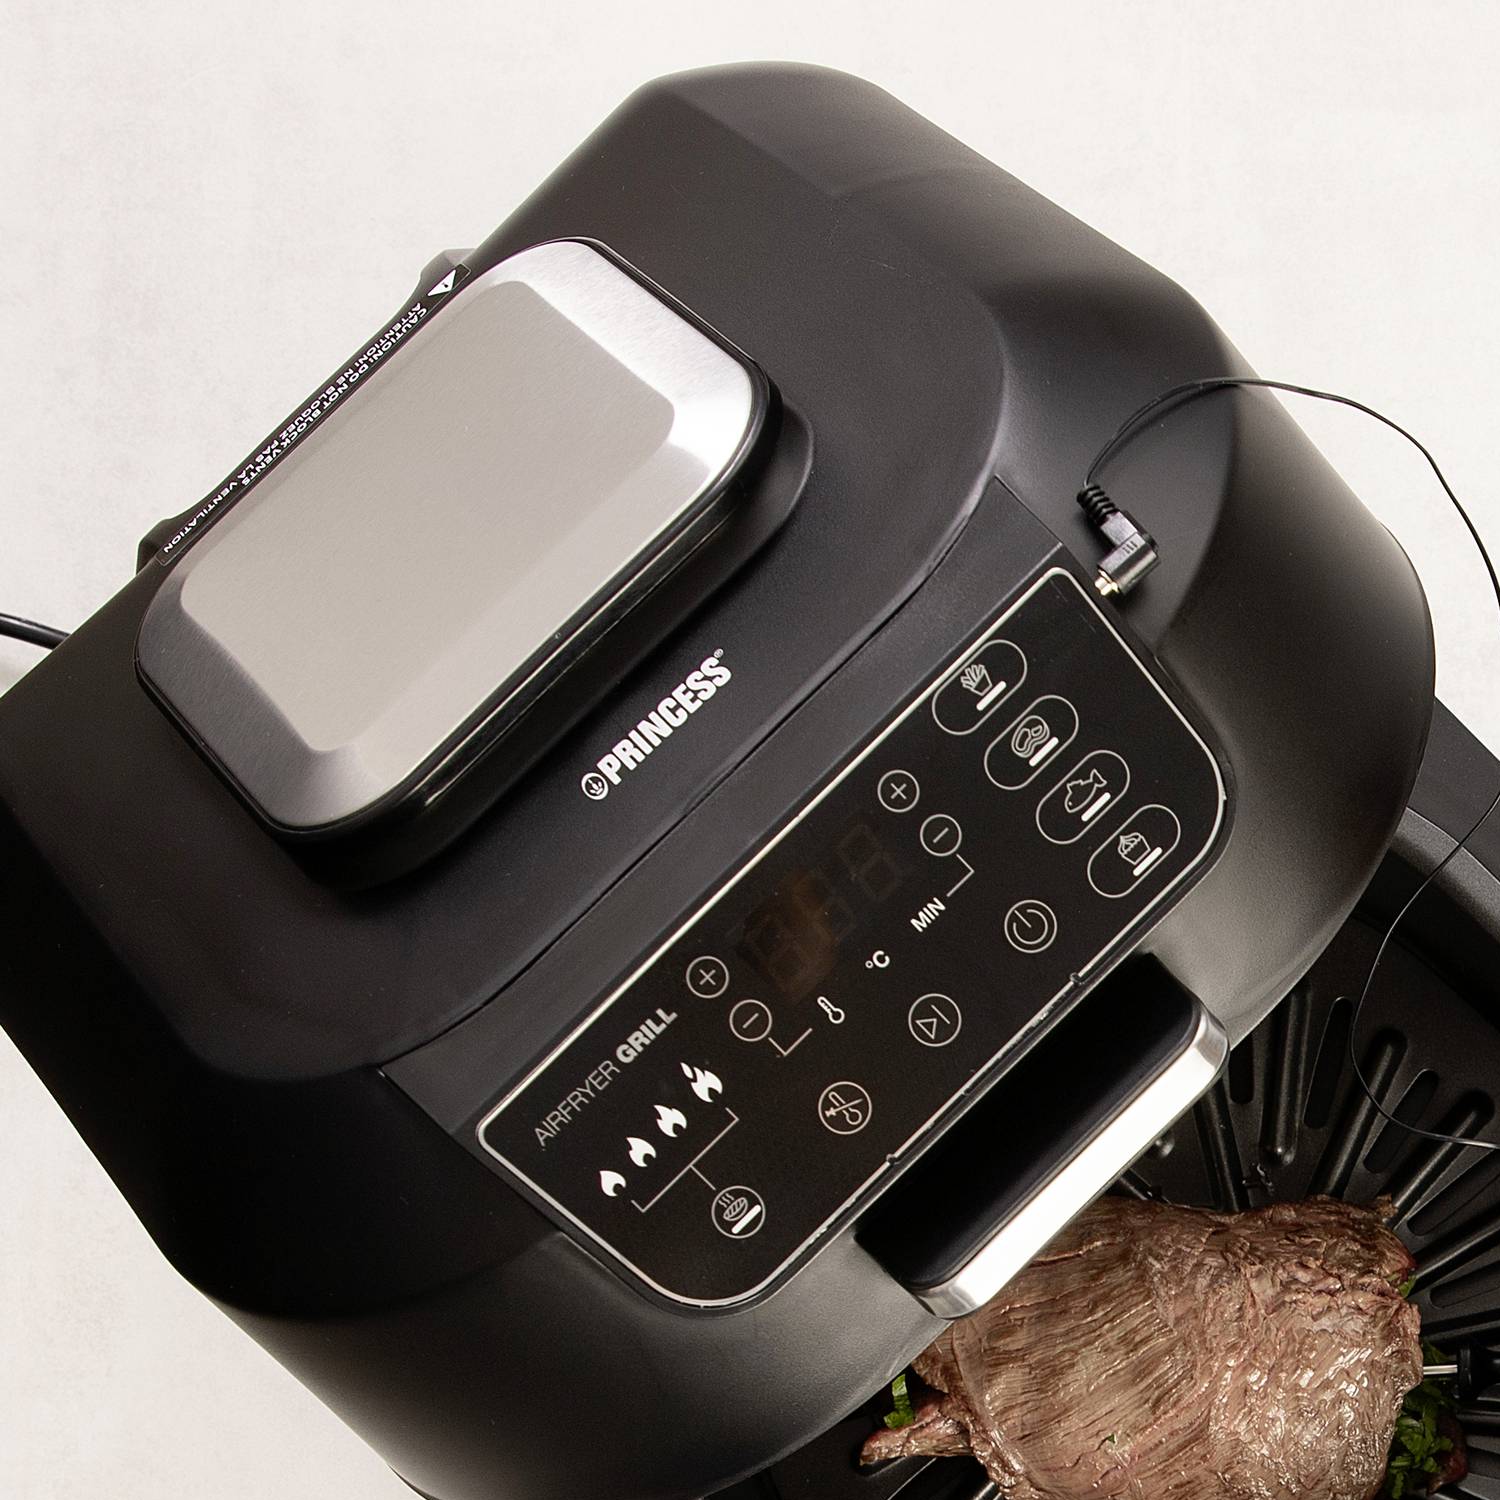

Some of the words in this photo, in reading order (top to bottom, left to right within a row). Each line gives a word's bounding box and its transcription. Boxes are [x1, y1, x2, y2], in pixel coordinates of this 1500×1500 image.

[336, 368, 354, 385] NE
[349, 363, 369, 383] DO
[279, 385, 336, 440] BLOQUEZ
[322, 382, 349, 410] NOT
[280, 408, 322, 448] BLOCK
[241, 448, 282, 486] VENTS
[255, 439, 279, 463] PAS
[237, 463, 255, 479] LA
[163, 481, 238, 553] VENTILATION
[910, 897, 946, 933] MIN
[534, 1060, 621, 1147] AIRFRYER
[615, 1008, 679, 1064] GRILL
